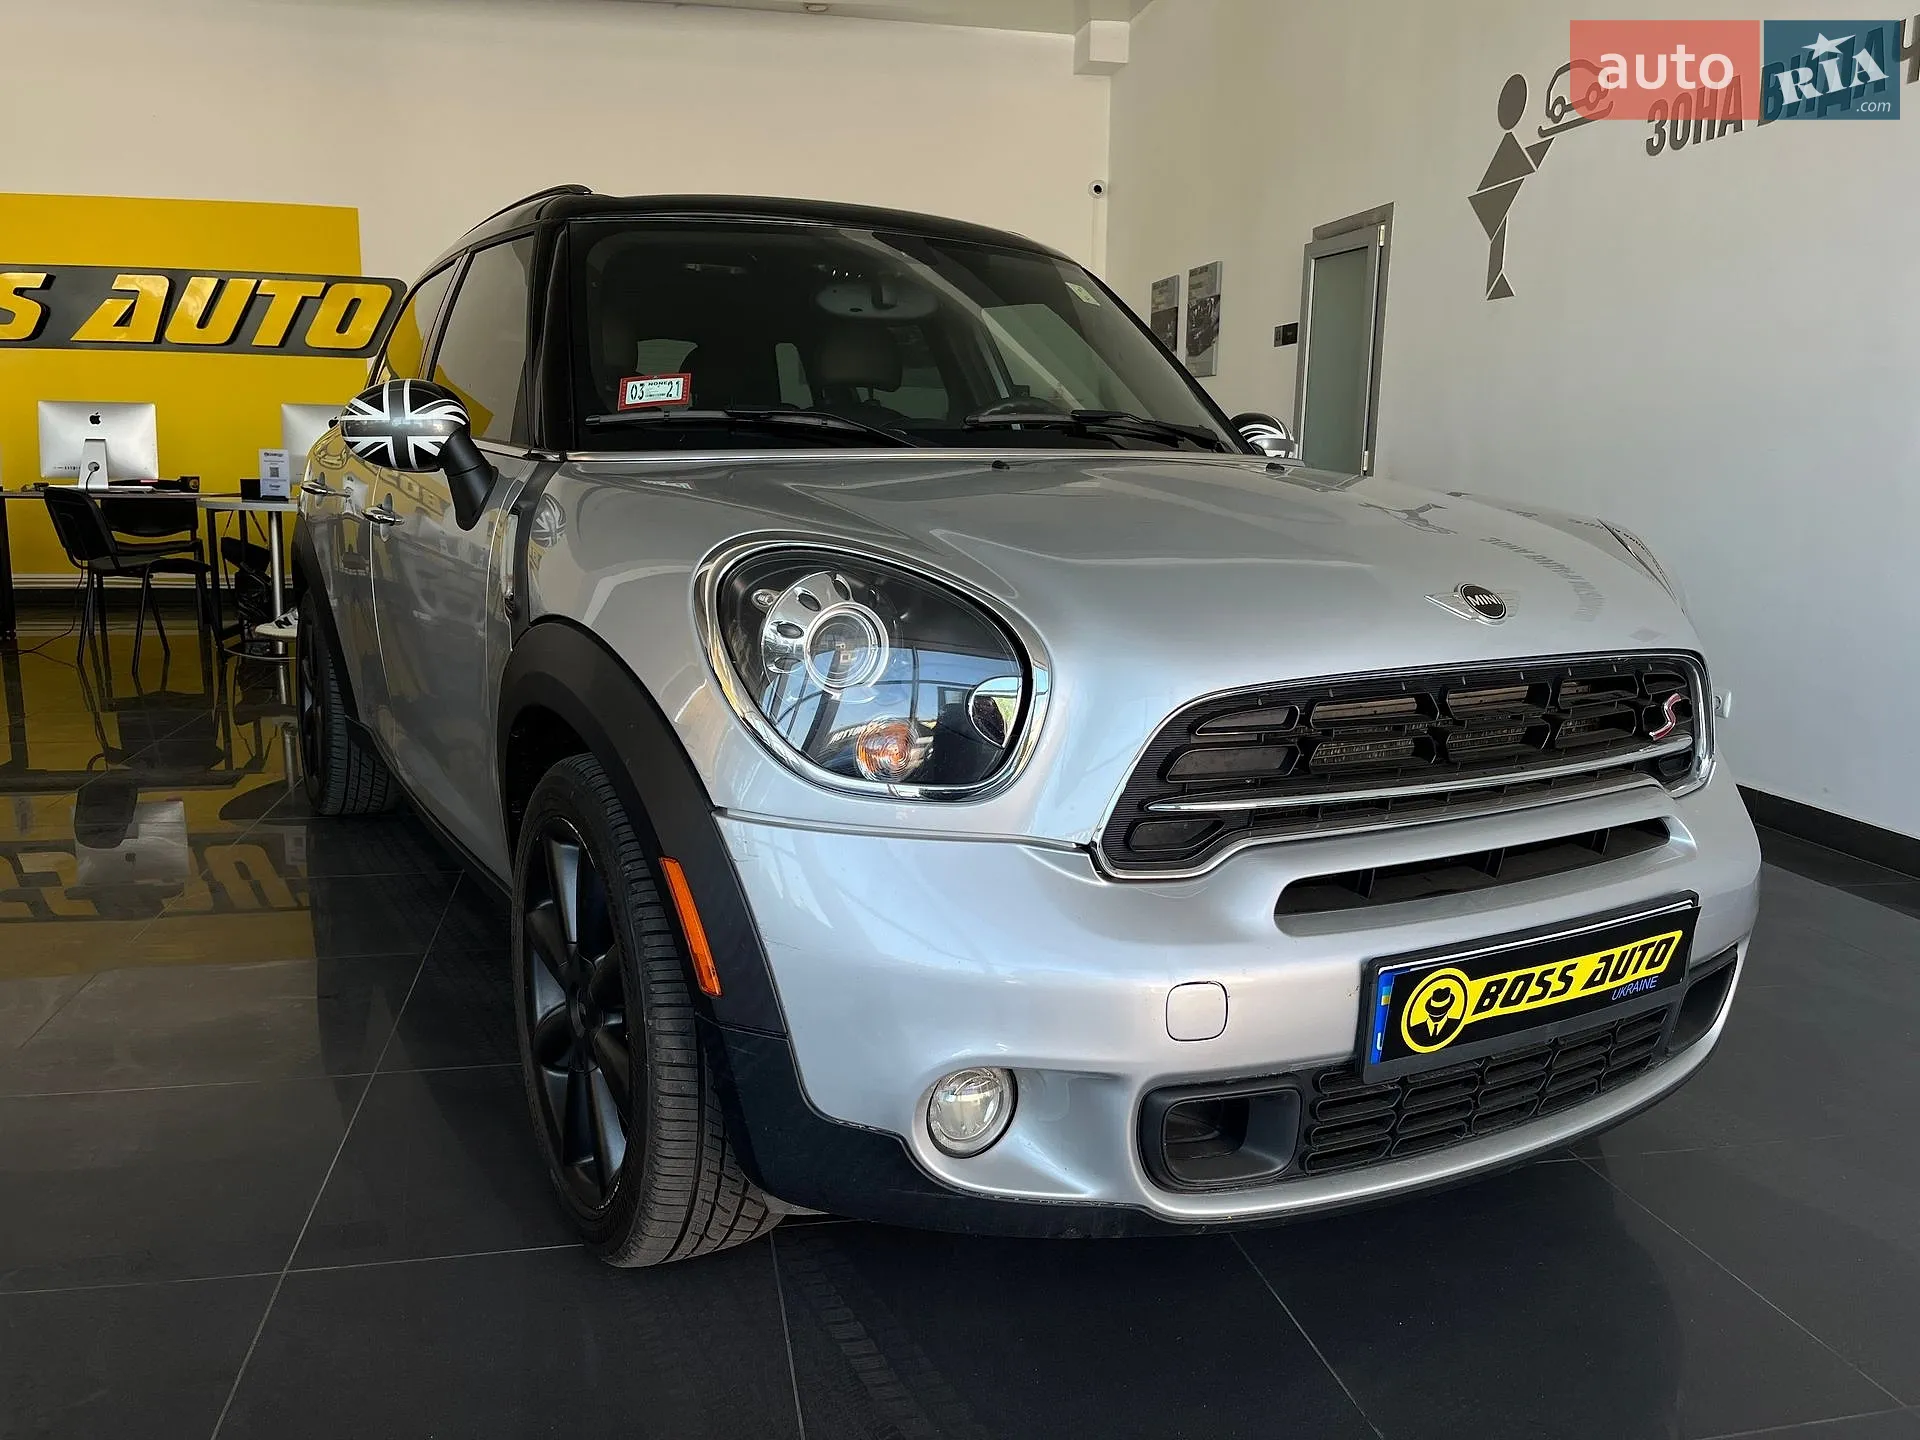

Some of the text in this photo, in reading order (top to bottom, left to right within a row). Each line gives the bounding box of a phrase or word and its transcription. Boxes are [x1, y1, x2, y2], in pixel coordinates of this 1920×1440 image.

[1645, 75, 1744, 157] ЗОНА
[70, 274, 394, 350] AUTO
[630, 383, 645, 401] 03
[1466, 594, 1501, 607] MINI
[1648, 692, 1682, 741] S
[1472, 936, 1676, 1016] BOSS AUTO
[1611, 975, 1659, 1001] UKRAINE
